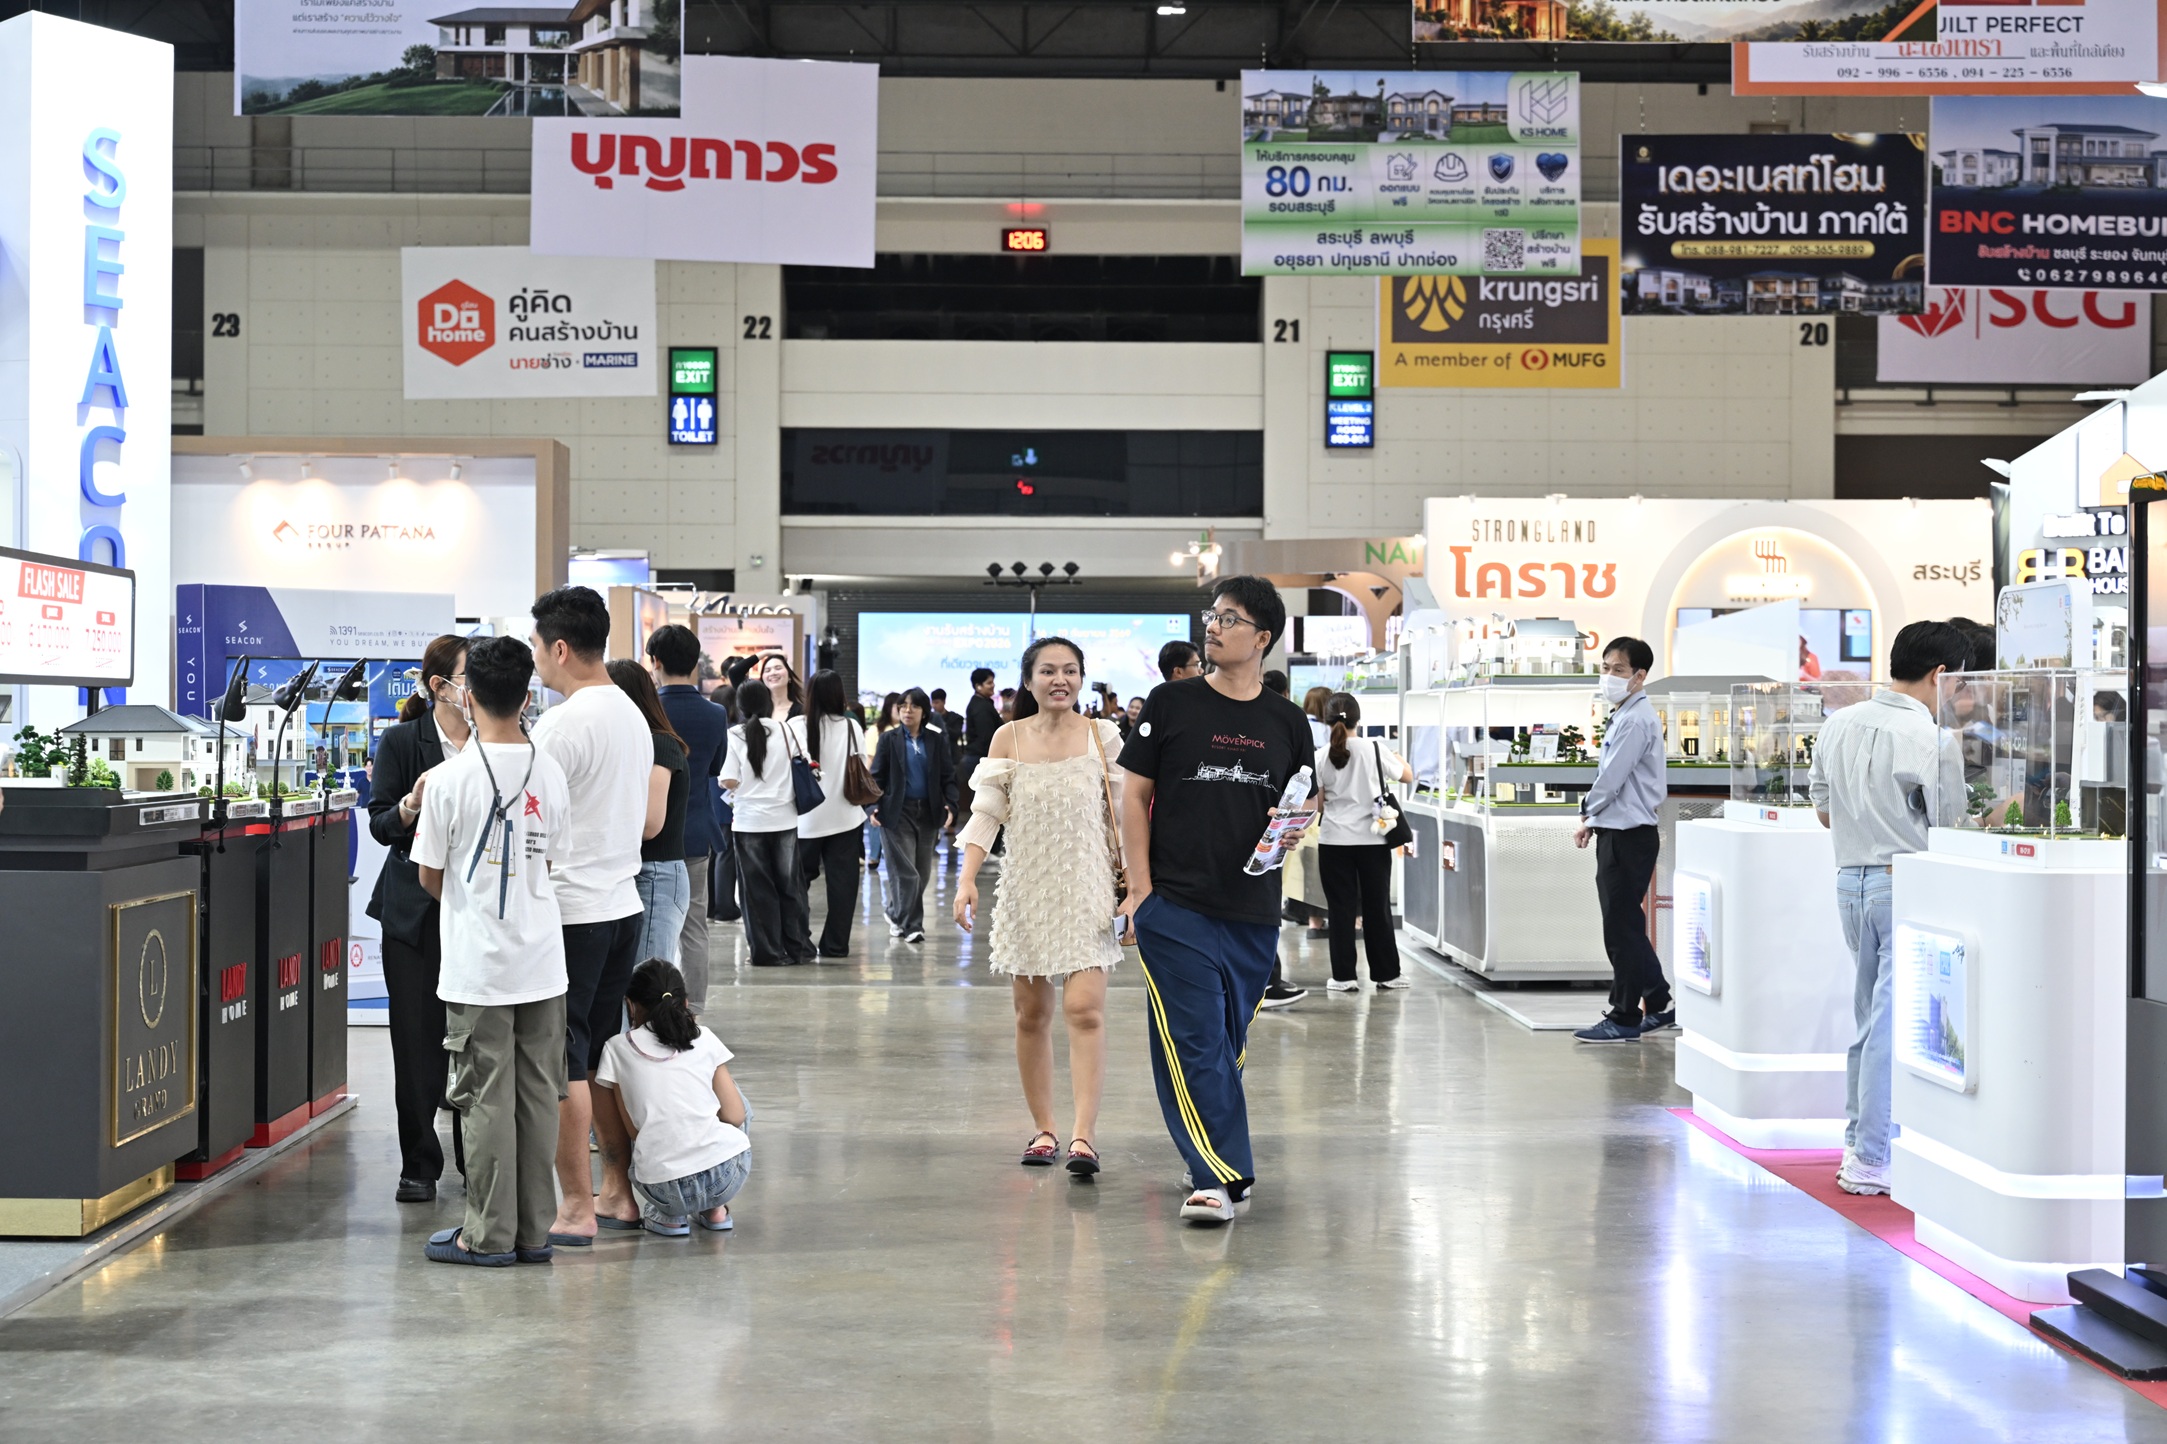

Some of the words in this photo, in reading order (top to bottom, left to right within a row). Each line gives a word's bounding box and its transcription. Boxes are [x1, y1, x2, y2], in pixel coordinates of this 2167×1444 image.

[1986, 17, 2084, 33] PERFECT
[1803, 43, 1870, 58] รับสร้างบ้าน
[1899, 38, 2002, 57] ฉะเชงเทรา
[1837, 67, 1860, 78] 092
[1878, 67, 1900, 78] 996
[1520, 128, 1534, 138] KS
[1536, 128, 1568, 138] HOME
[571, 132, 838, 192] บุญถาวร
[1256, 149, 1356, 165] ให้บริการครอบคลุม
[1265, 165, 1311, 198] 80
[1317, 176, 1353, 192] กม.
[1658, 154, 1886, 194] เดอะเบสท์โฮม
[1380, 184, 1420, 193] ออกแบบ
[1268, 200, 1335, 217] รอบสระบุรี
[1638, 203, 1807, 235] รับสร้างบ้าน
[1818, 202, 1908, 235] ภาคใต้
[1939, 210, 2016, 234] BNC
[1317, 229, 1363, 249] สระบุรี
[1370, 229, 1414, 249] ลพบุรี
[1532, 230, 1565, 241] ปรึกษา
[1527, 243, 1571, 255] สร้างบ้าน
[2053, 247, 2087, 264] ชลบุรี
[2090, 249, 2128, 261] ระยอง
[1331, 252, 1390, 270] ปทุมธานี
[1398, 252, 1457, 267] ปากช่อง
[1541, 257, 1557, 269] ฟรี
[1479, 275, 1599, 306] krungsri
[509, 288, 572, 323] คู่คิด
[1989, 288, 2137, 329] SCG
[212, 313, 240, 338] 23
[509, 320, 638, 341] คนสร้างบ้าน
[743, 316, 772, 340] 22
[1274, 319, 1300, 343] 21
[1479, 308, 1534, 334] กรุงศรี
[428, 326, 485, 342] home
[1800, 322, 1829, 346] 20
[510, 353, 572, 369] นายช่าง
[586, 354, 636, 366] MARINE
[1395, 354, 1408, 367] A
[1414, 353, 1489, 367] member
[1494, 353, 1512, 368] of
[1553, 353, 1606, 368] MUFG
[676, 370, 711, 383] EXIT
[1333, 373, 1368, 387] EXIT
[671, 430, 714, 442] TOILET
[309, 525, 354, 539] FOUR
[361, 525, 435, 540] PATTANA
[1472, 519, 1596, 542] STRONGLAND
[1450, 546, 1617, 599] โคราช
[1912, 559, 1982, 587] สระบุรี
[24, 566, 56, 597] FLASH
[57, 571, 80, 601] SALE
[225, 636, 262, 645] SEACON
[338, 626, 358, 636] 1391
[355, 640, 389, 648] DREAM,
[186, 657, 196, 701] YOU
[1211, 734, 1265, 749] MÖVENPICK
[321, 937, 341, 971] LANDY
[149, 960, 158, 997] L
[278, 953, 301, 989] LANDY
[323, 972, 338, 990] HOME
[221, 962, 247, 1003] LANDY
[280, 990, 298, 1011] HOME
[222, 1000, 246, 1024] HOME
[126, 1040, 178, 1093] LANDY
[134, 1089, 167, 1120] GRAND
